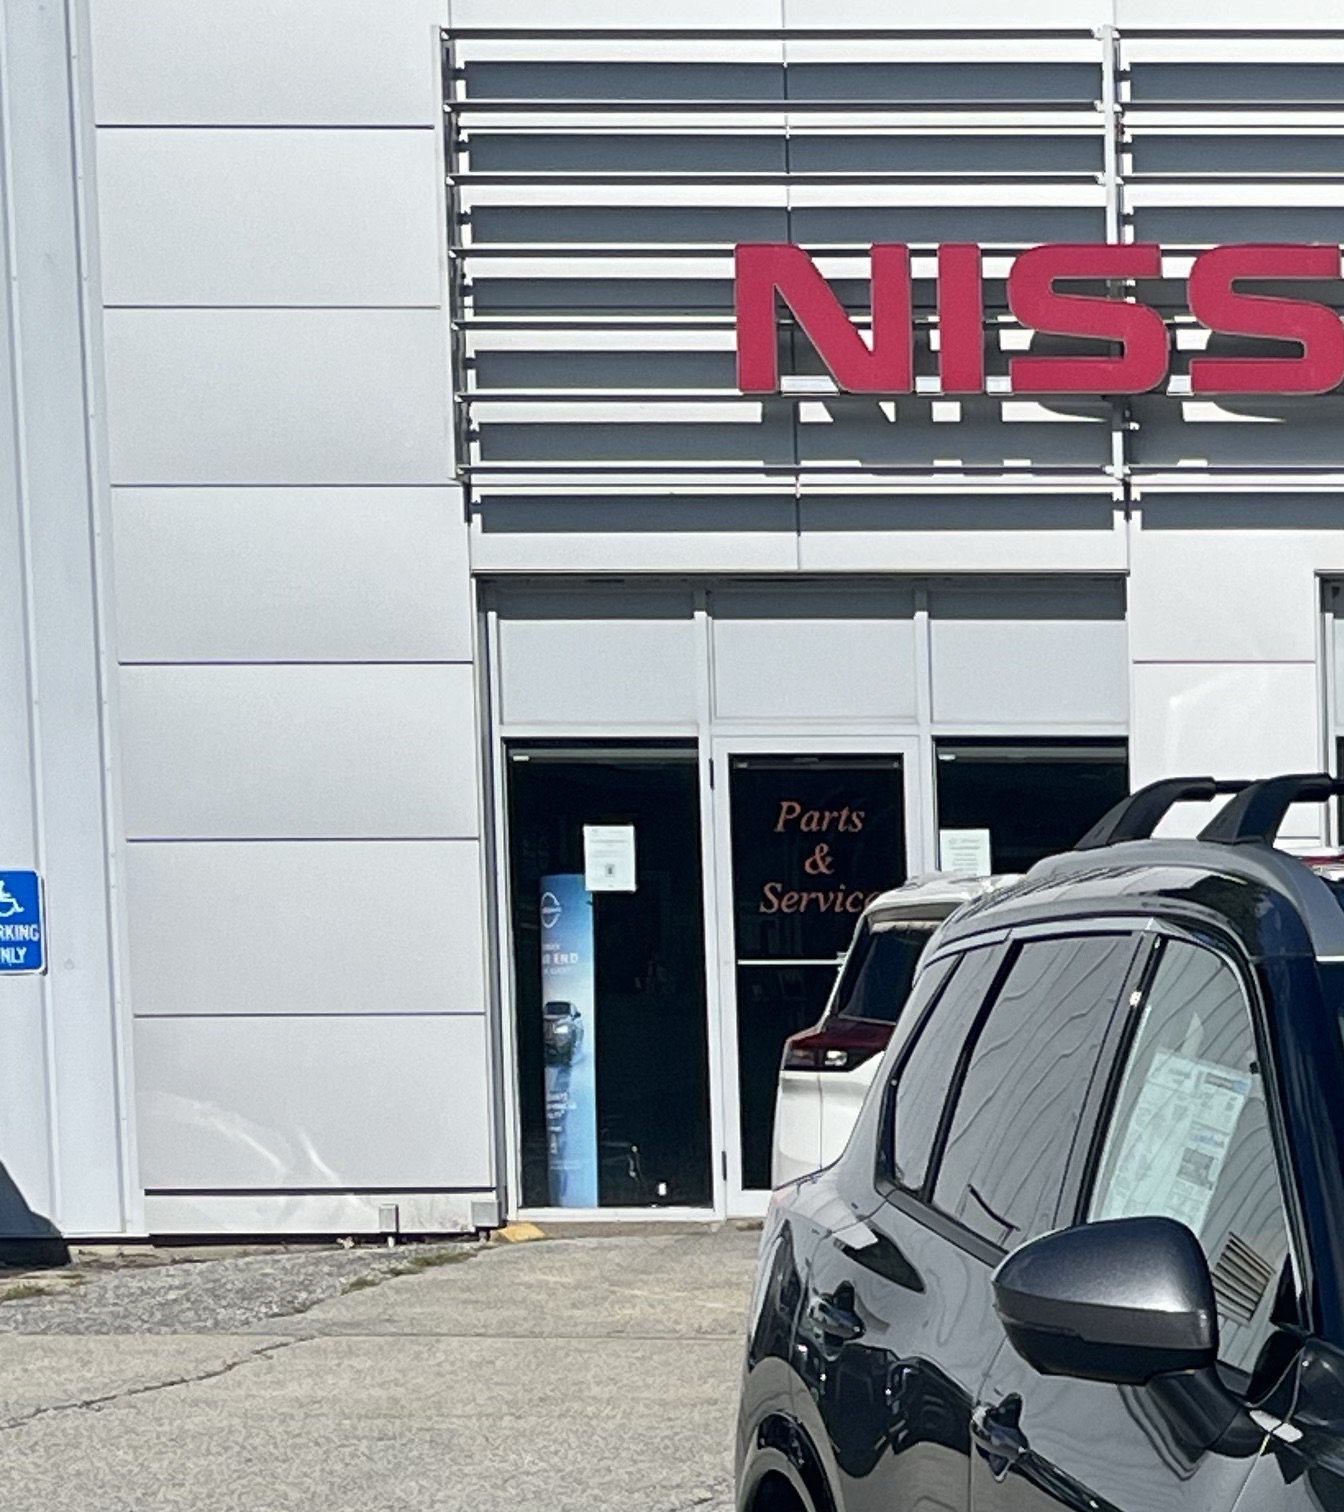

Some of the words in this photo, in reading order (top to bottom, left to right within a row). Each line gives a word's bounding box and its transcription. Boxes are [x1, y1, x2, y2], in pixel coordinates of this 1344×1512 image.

[774, 801, 865, 832] Parts
[804, 843, 835, 875] &
[0, 924, 40, 942] RKING
[0, 947, 27, 964] NLY
